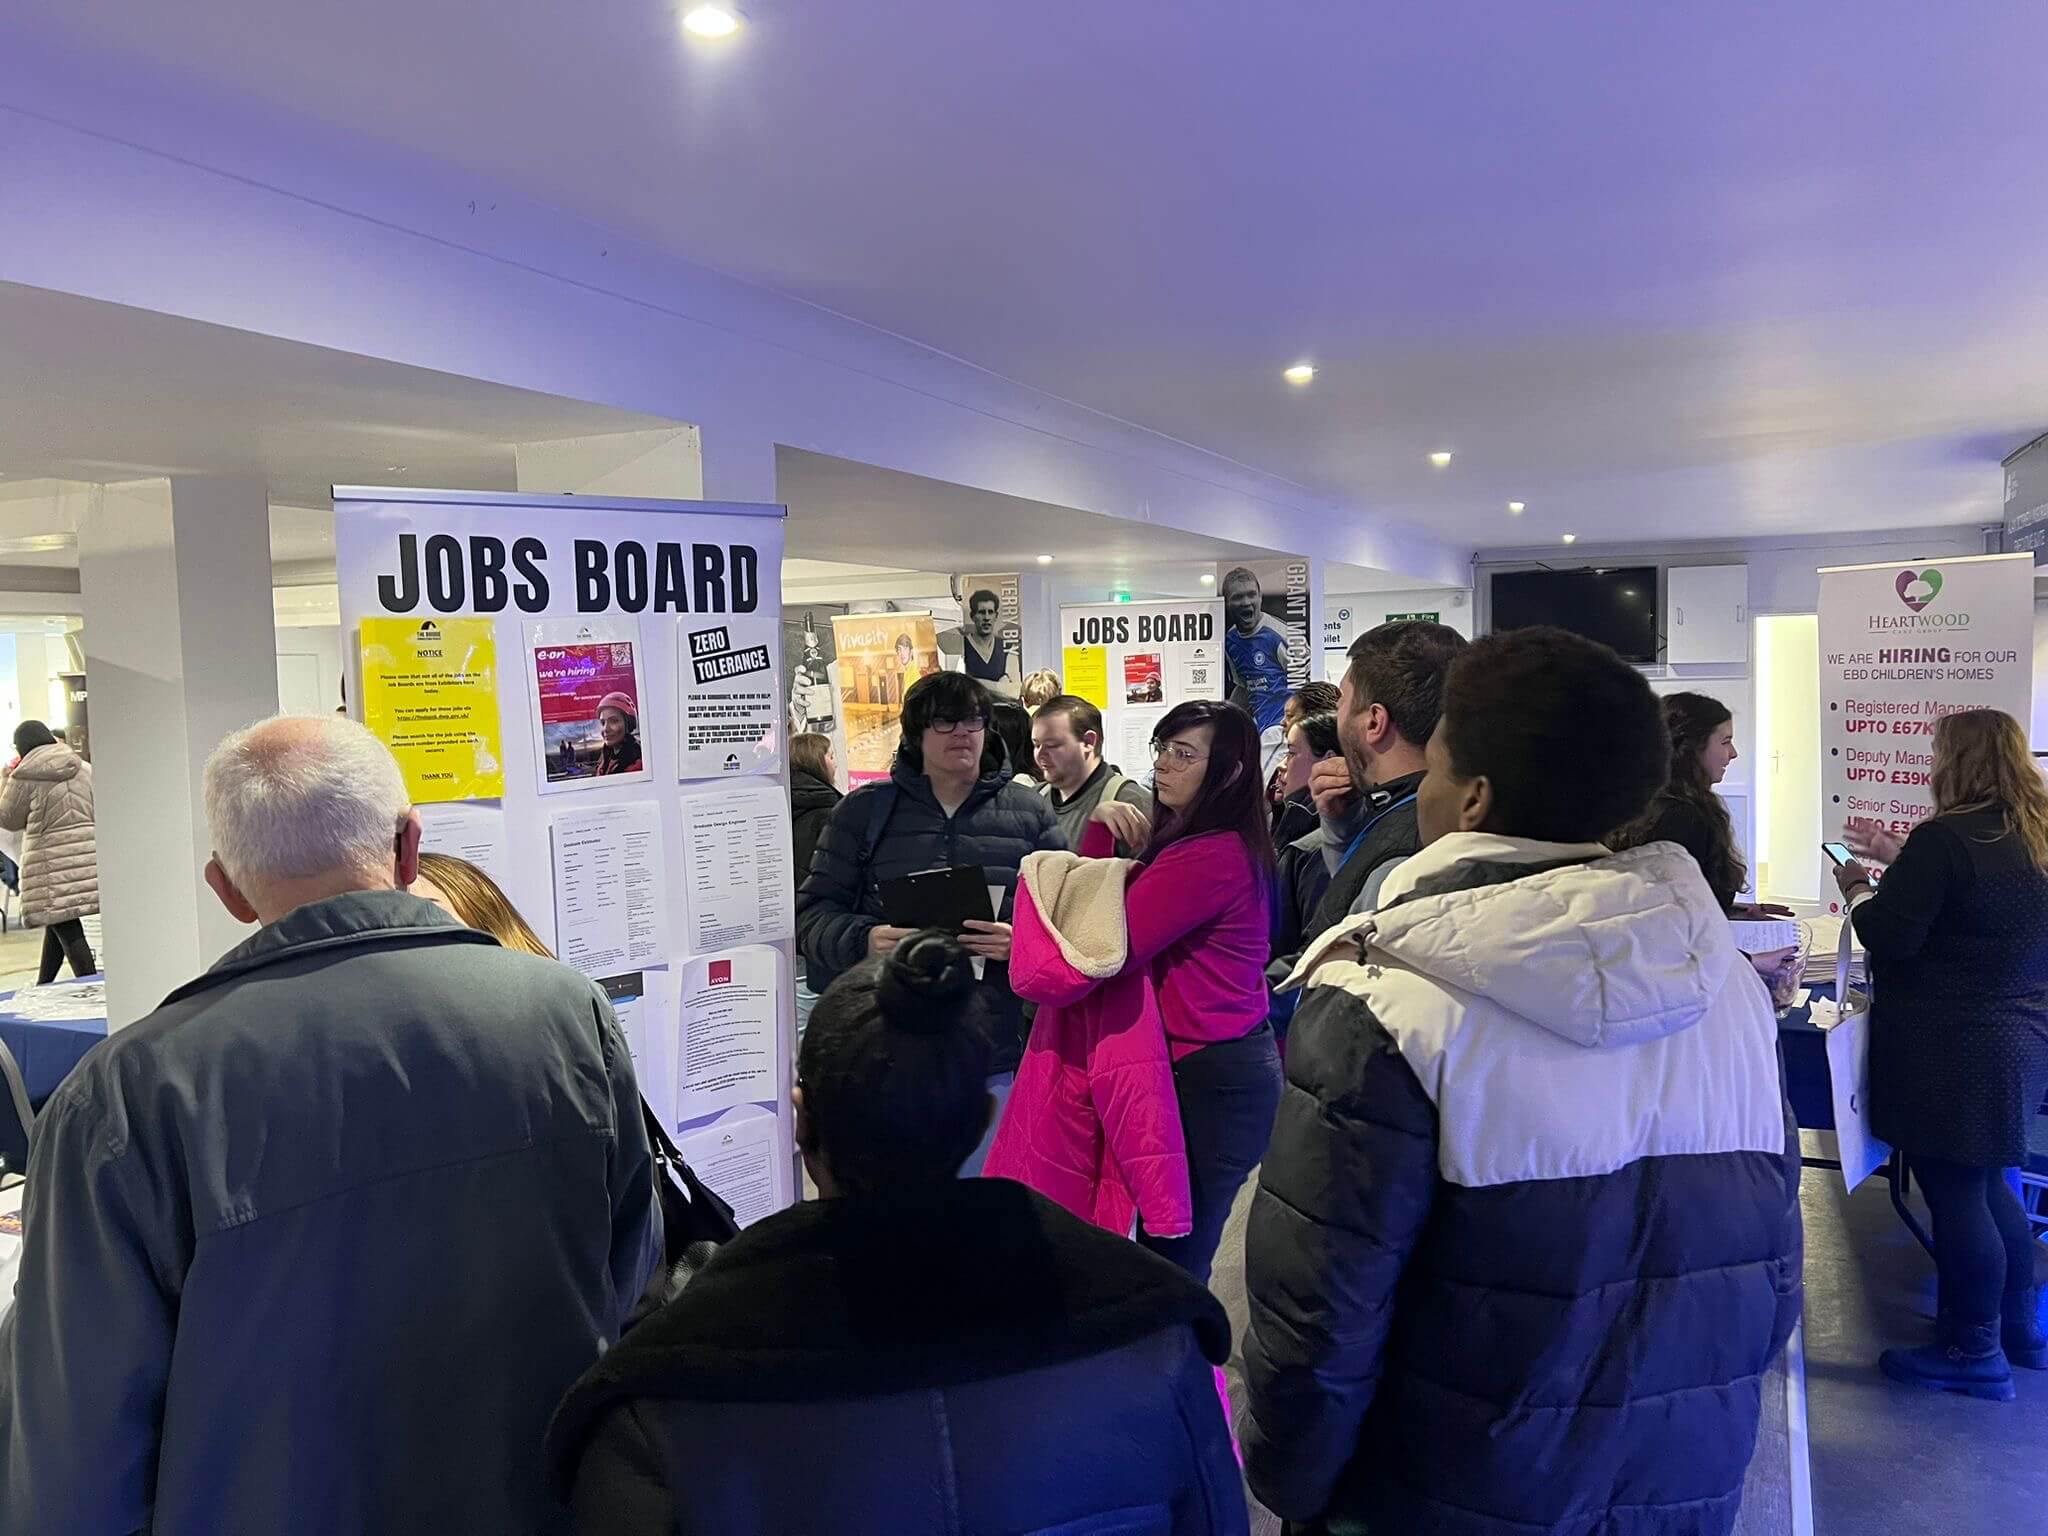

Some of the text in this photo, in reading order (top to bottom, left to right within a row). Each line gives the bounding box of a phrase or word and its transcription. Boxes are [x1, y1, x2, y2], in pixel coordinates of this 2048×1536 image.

[378, 534, 758, 614] JOBS BOARD
[1000, 577, 1020, 656] TERRY BLY
[1072, 613, 1213, 645] JOBS BOARD
[1286, 564, 1307, 689] GRANT MCCANN
[693, 630, 726, 654] ZERO
[1827, 647, 2017, 665] WE ARE HIRING FOR OUR
[539, 667, 596, 678] we're hiring
[697, 650, 767, 681] TOLERANCE
[1843, 668, 1994, 680] EBD CHILDREN'S HOMES
[1845, 700, 1919, 717] Registered
[1846, 720, 1934, 735] UPTO £67K
[1846, 748, 1934, 766] Deputy Mana
[1846, 768, 1931, 785] UPTO £39K
[1847, 796, 1934, 818] Senior Suppo
[1890, 820, 1910, 834] £3
[711, 976, 729, 985] AVON
